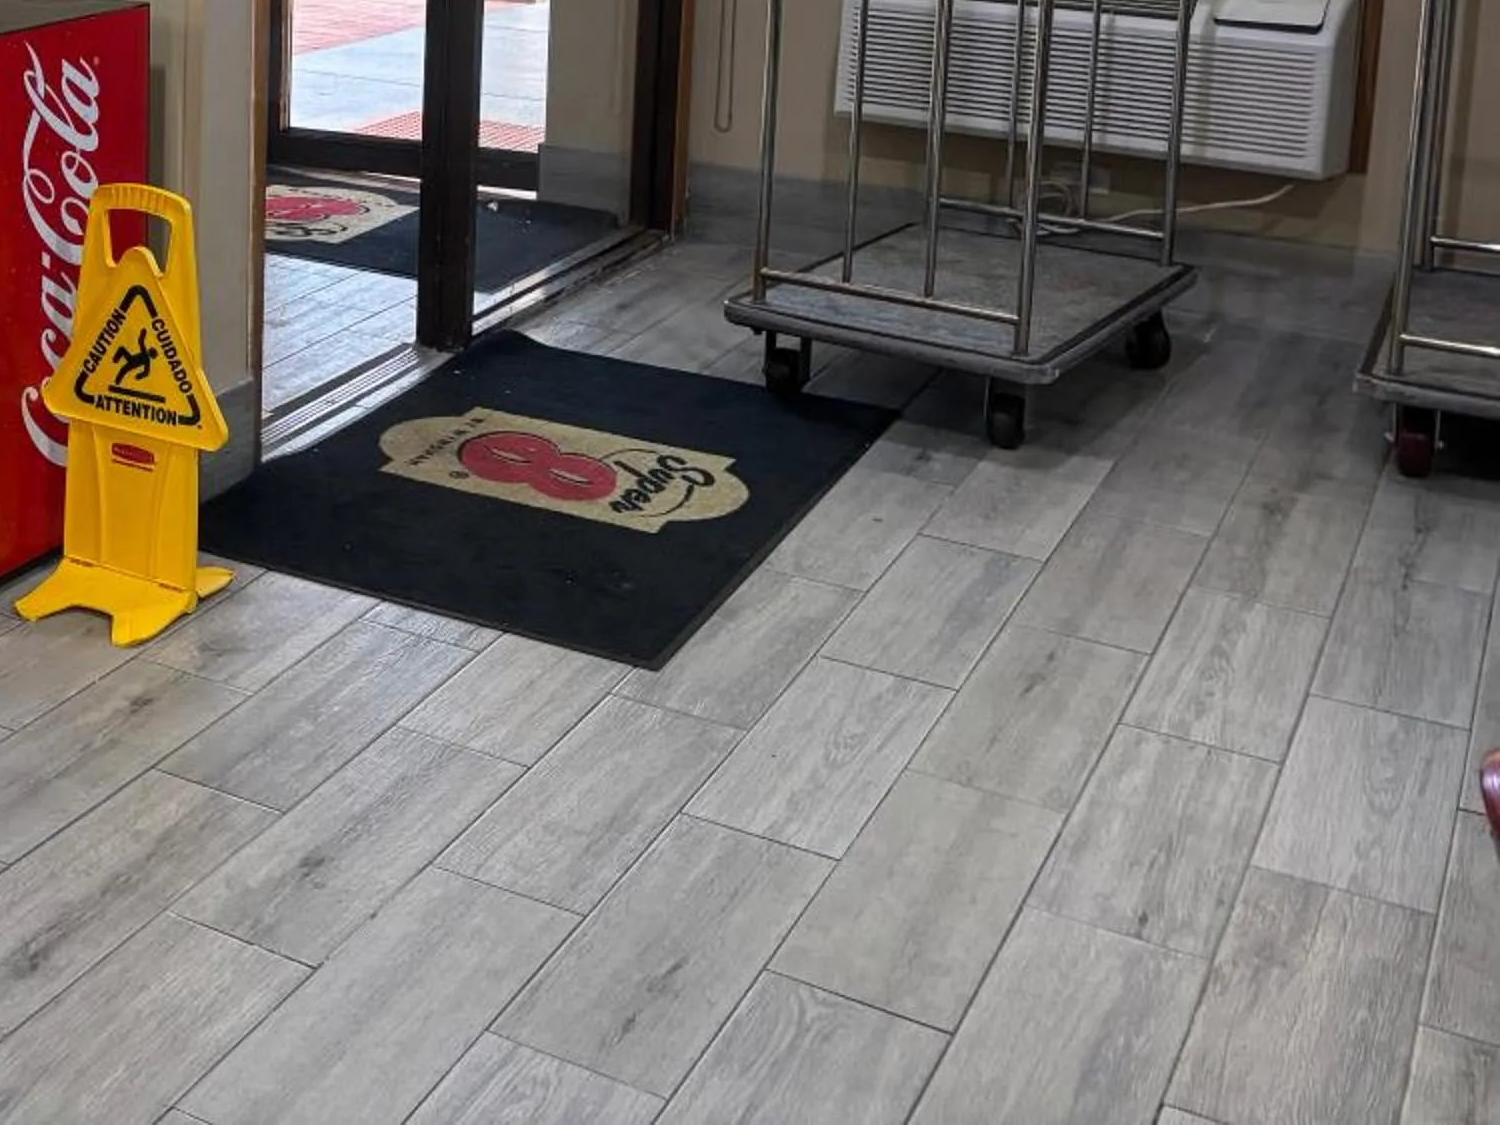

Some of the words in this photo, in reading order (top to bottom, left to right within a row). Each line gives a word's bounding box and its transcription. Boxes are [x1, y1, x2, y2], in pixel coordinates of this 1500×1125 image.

[21, 41, 100, 467] Cca-Cola
[83, 308, 128, 374] CAUTION
[151, 318, 193, 393] CUIDADO
[95, 395, 179, 426] ATTENTION
[608, 455, 716, 515] Super
